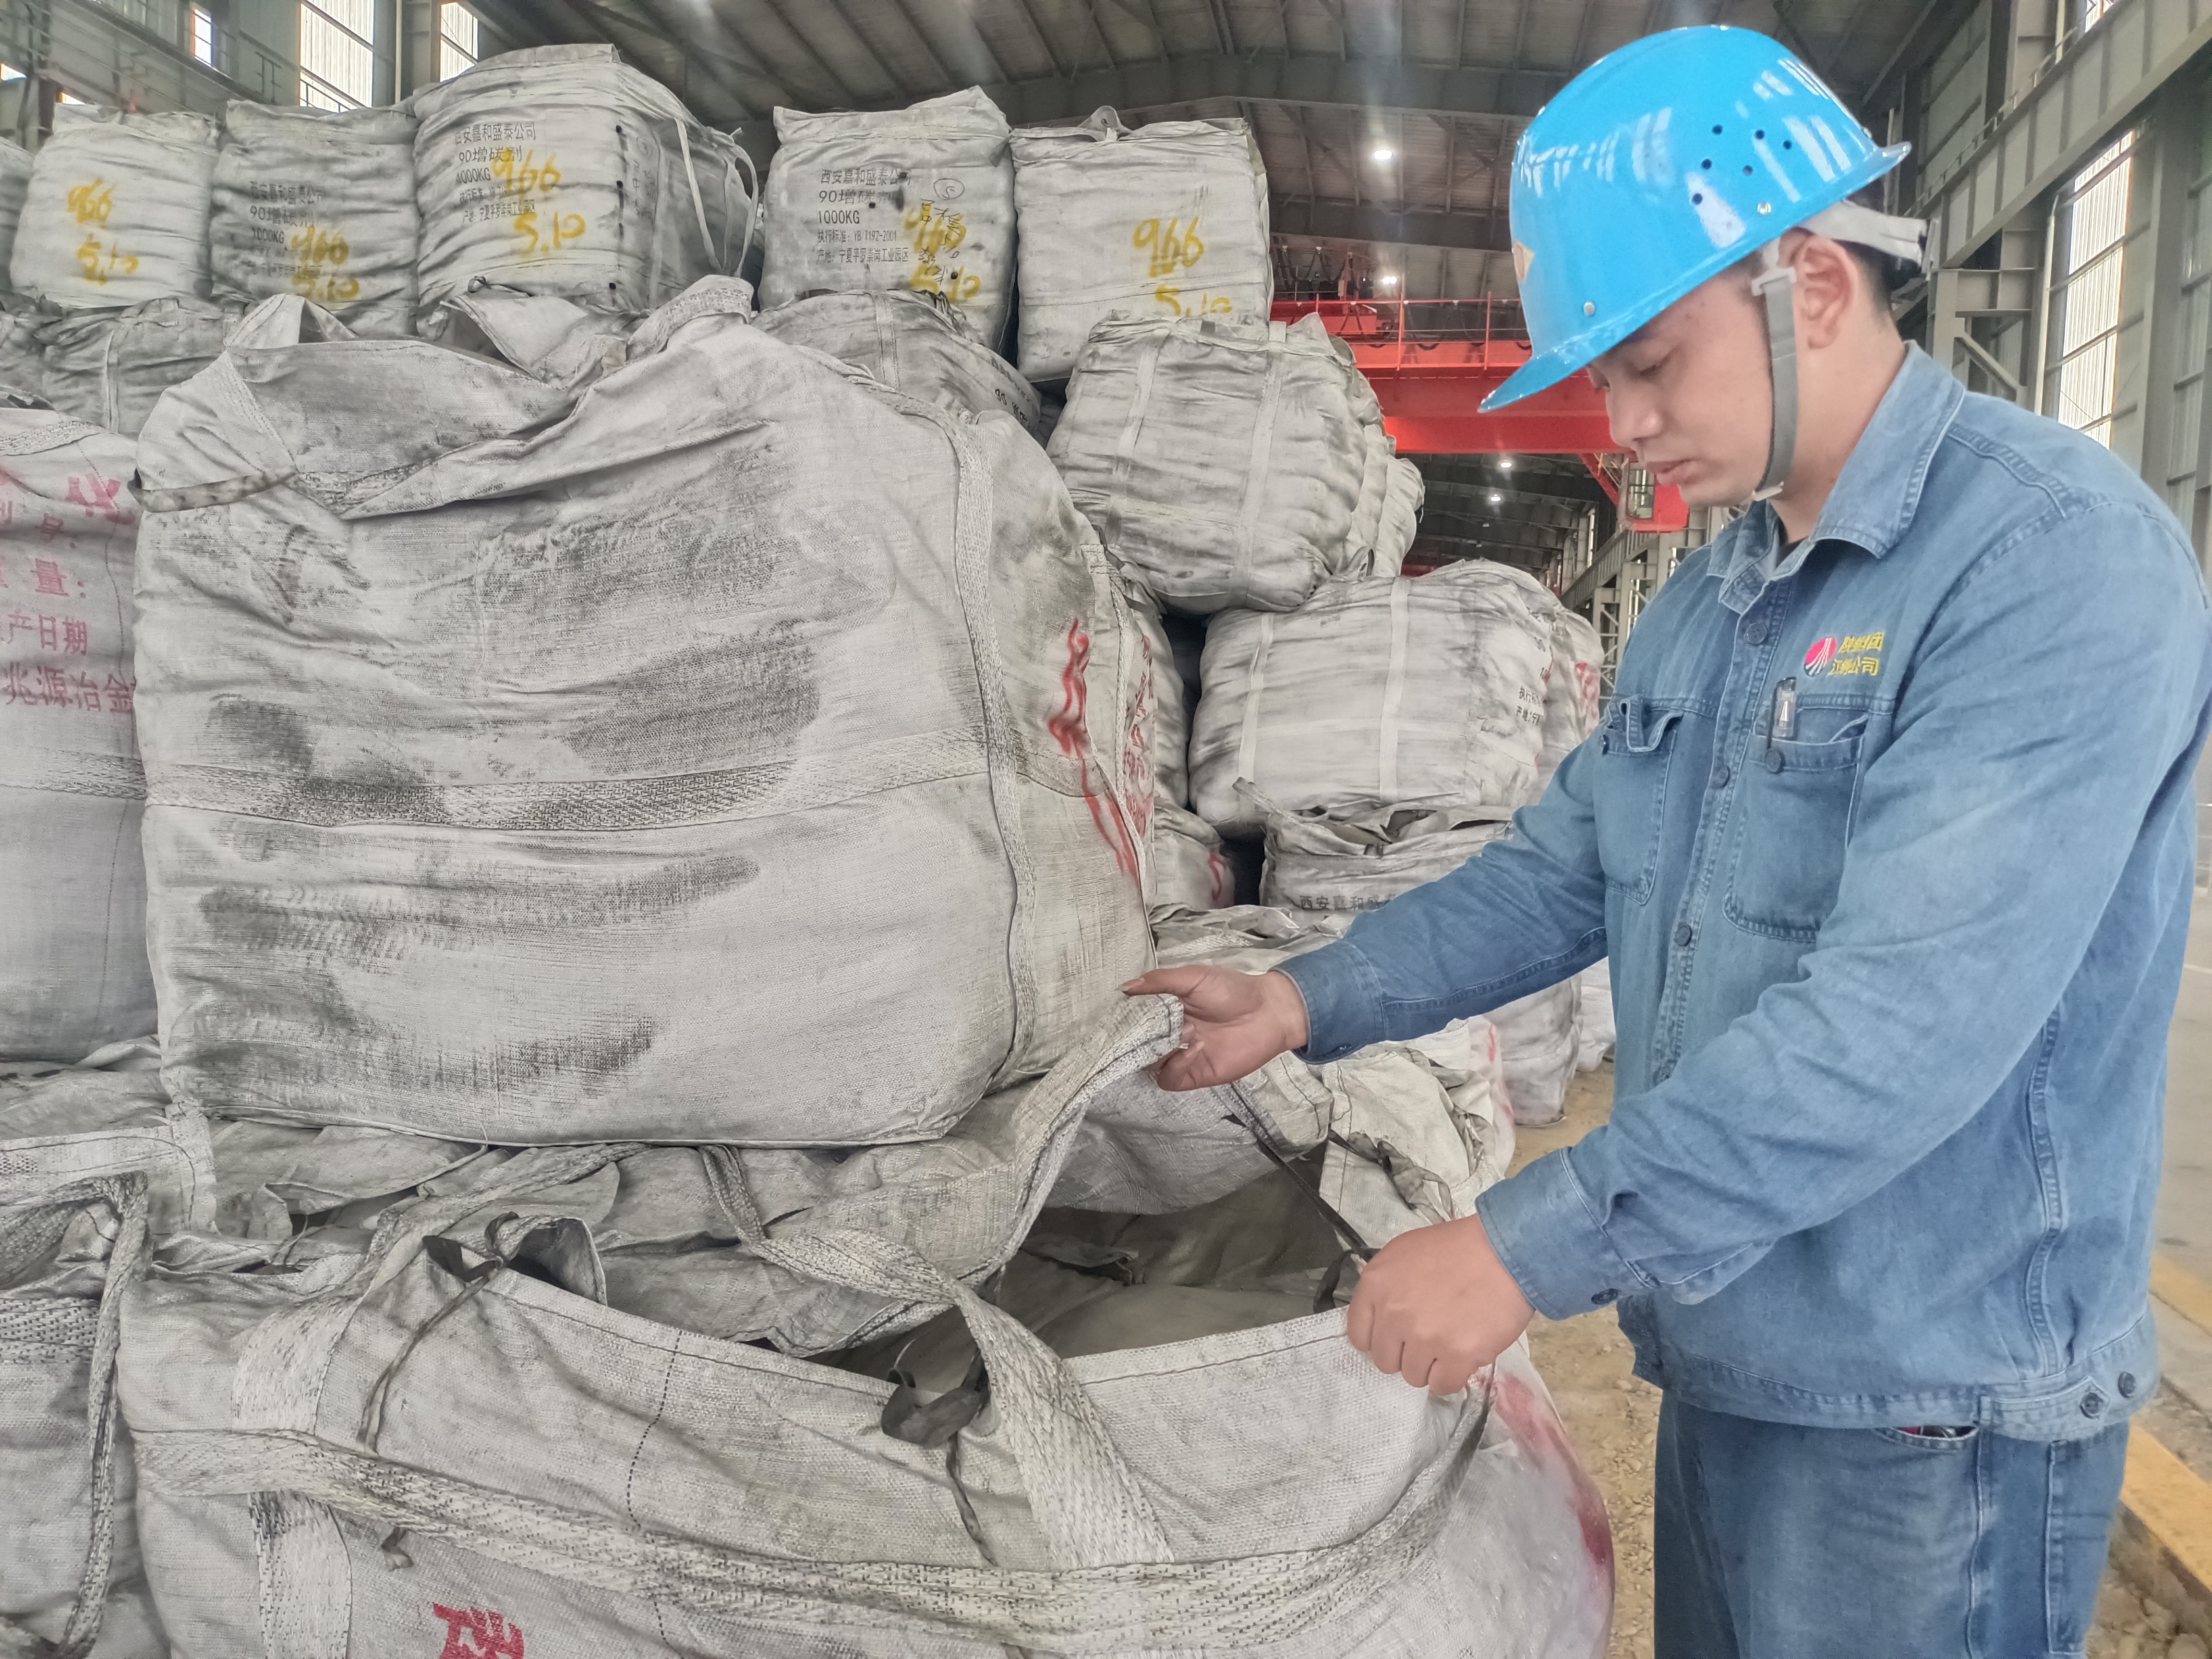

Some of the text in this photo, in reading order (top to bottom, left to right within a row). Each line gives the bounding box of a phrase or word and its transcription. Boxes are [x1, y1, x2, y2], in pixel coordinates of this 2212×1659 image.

[819, 210, 860, 224] 1000KG
[252, 227, 285, 243] 1000KG
[1133, 216, 1204, 278] 966
